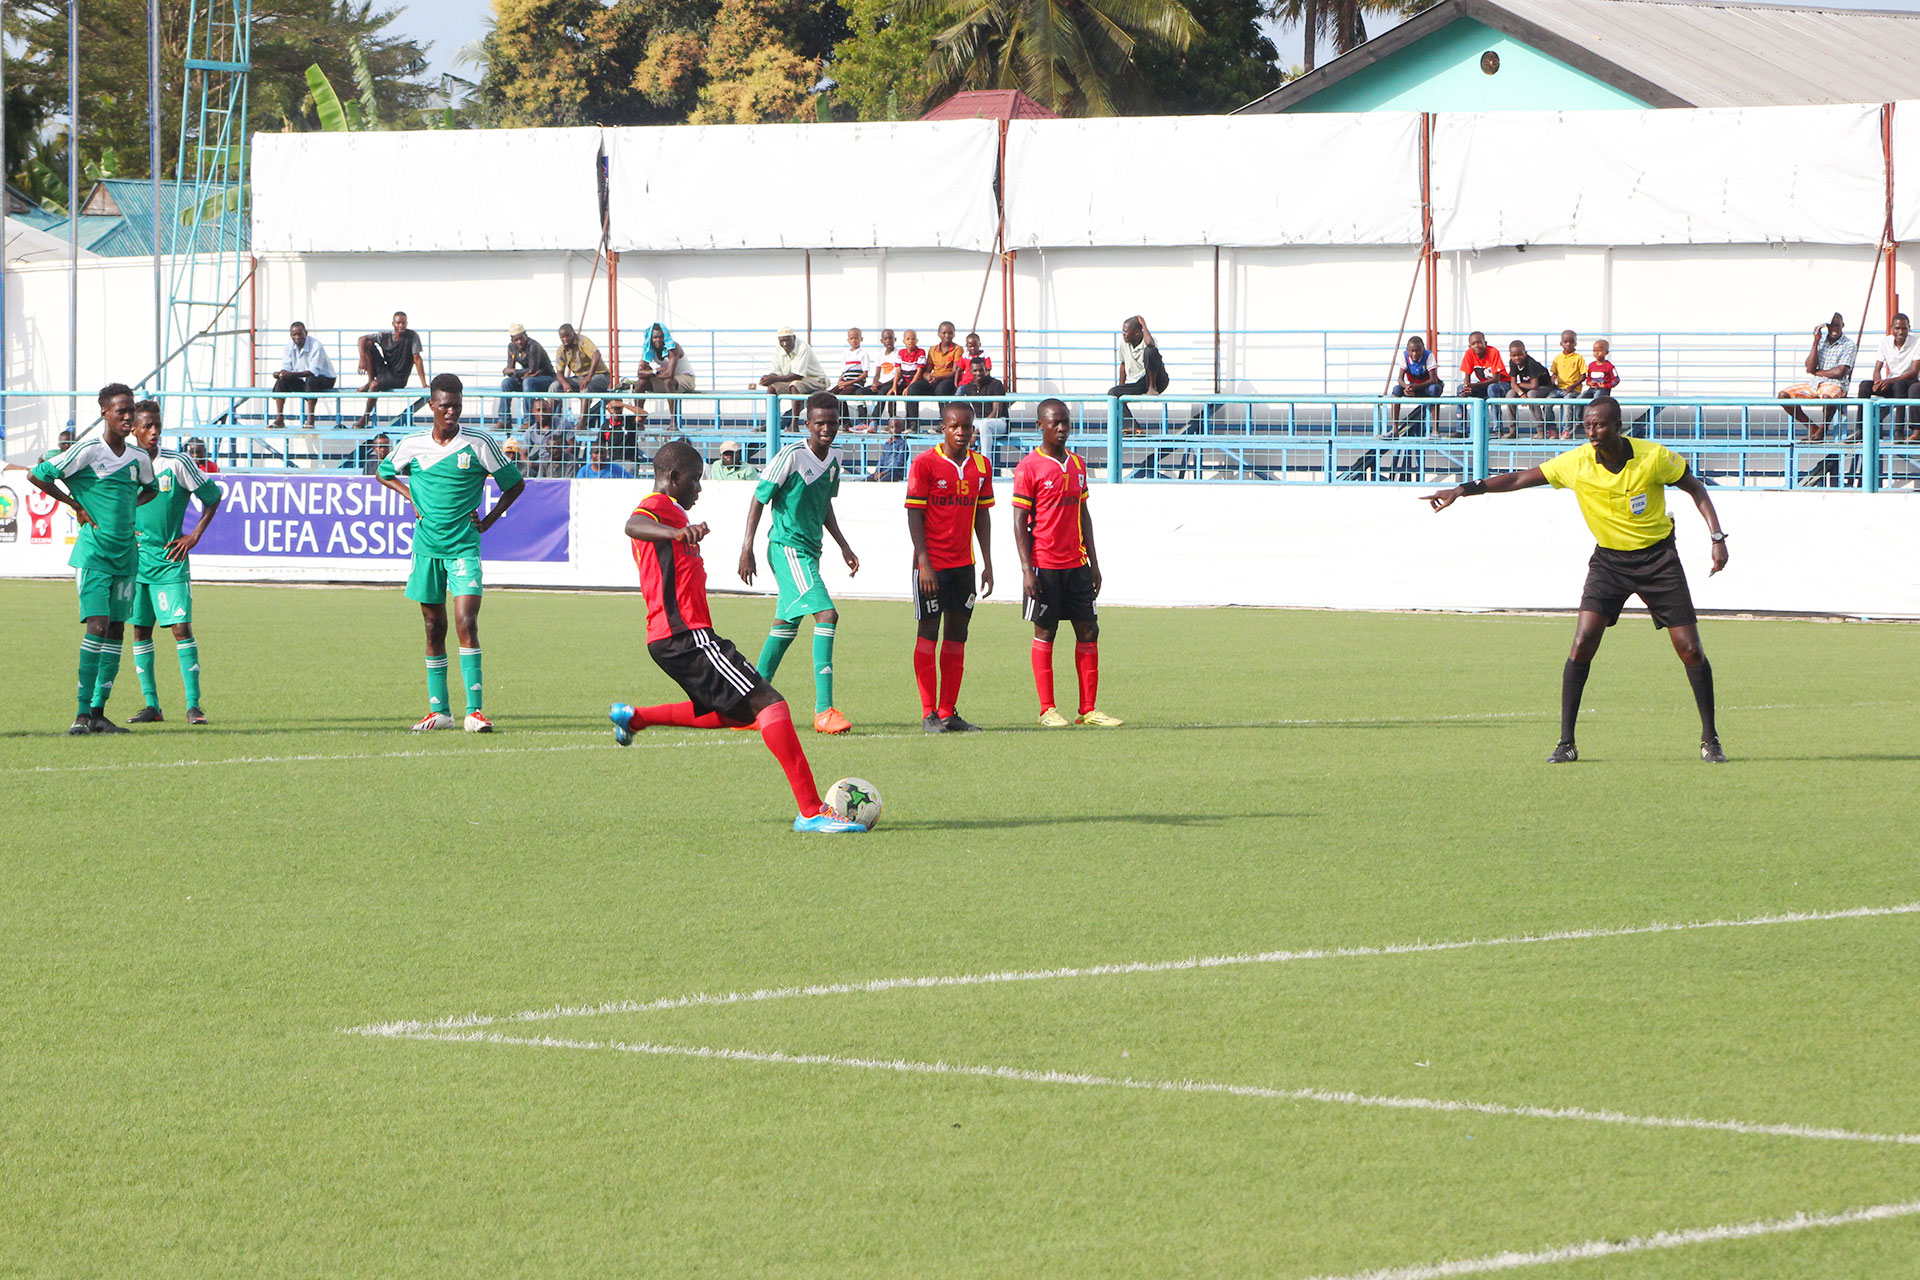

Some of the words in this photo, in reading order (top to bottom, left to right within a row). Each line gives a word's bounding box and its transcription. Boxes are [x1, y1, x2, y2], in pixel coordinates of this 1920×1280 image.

[956, 480, 969, 495] 15
[1062, 474, 1069, 491] 7
[931, 496, 976, 506] UGANDA
[244, 519, 320, 553] UEFA
[326, 520, 416, 555] ASSIS
[117, 581, 133, 601] 14
[157, 591, 169, 611] 8
[926, 599, 939, 613] 15
[1038, 603, 1048, 617] 7
